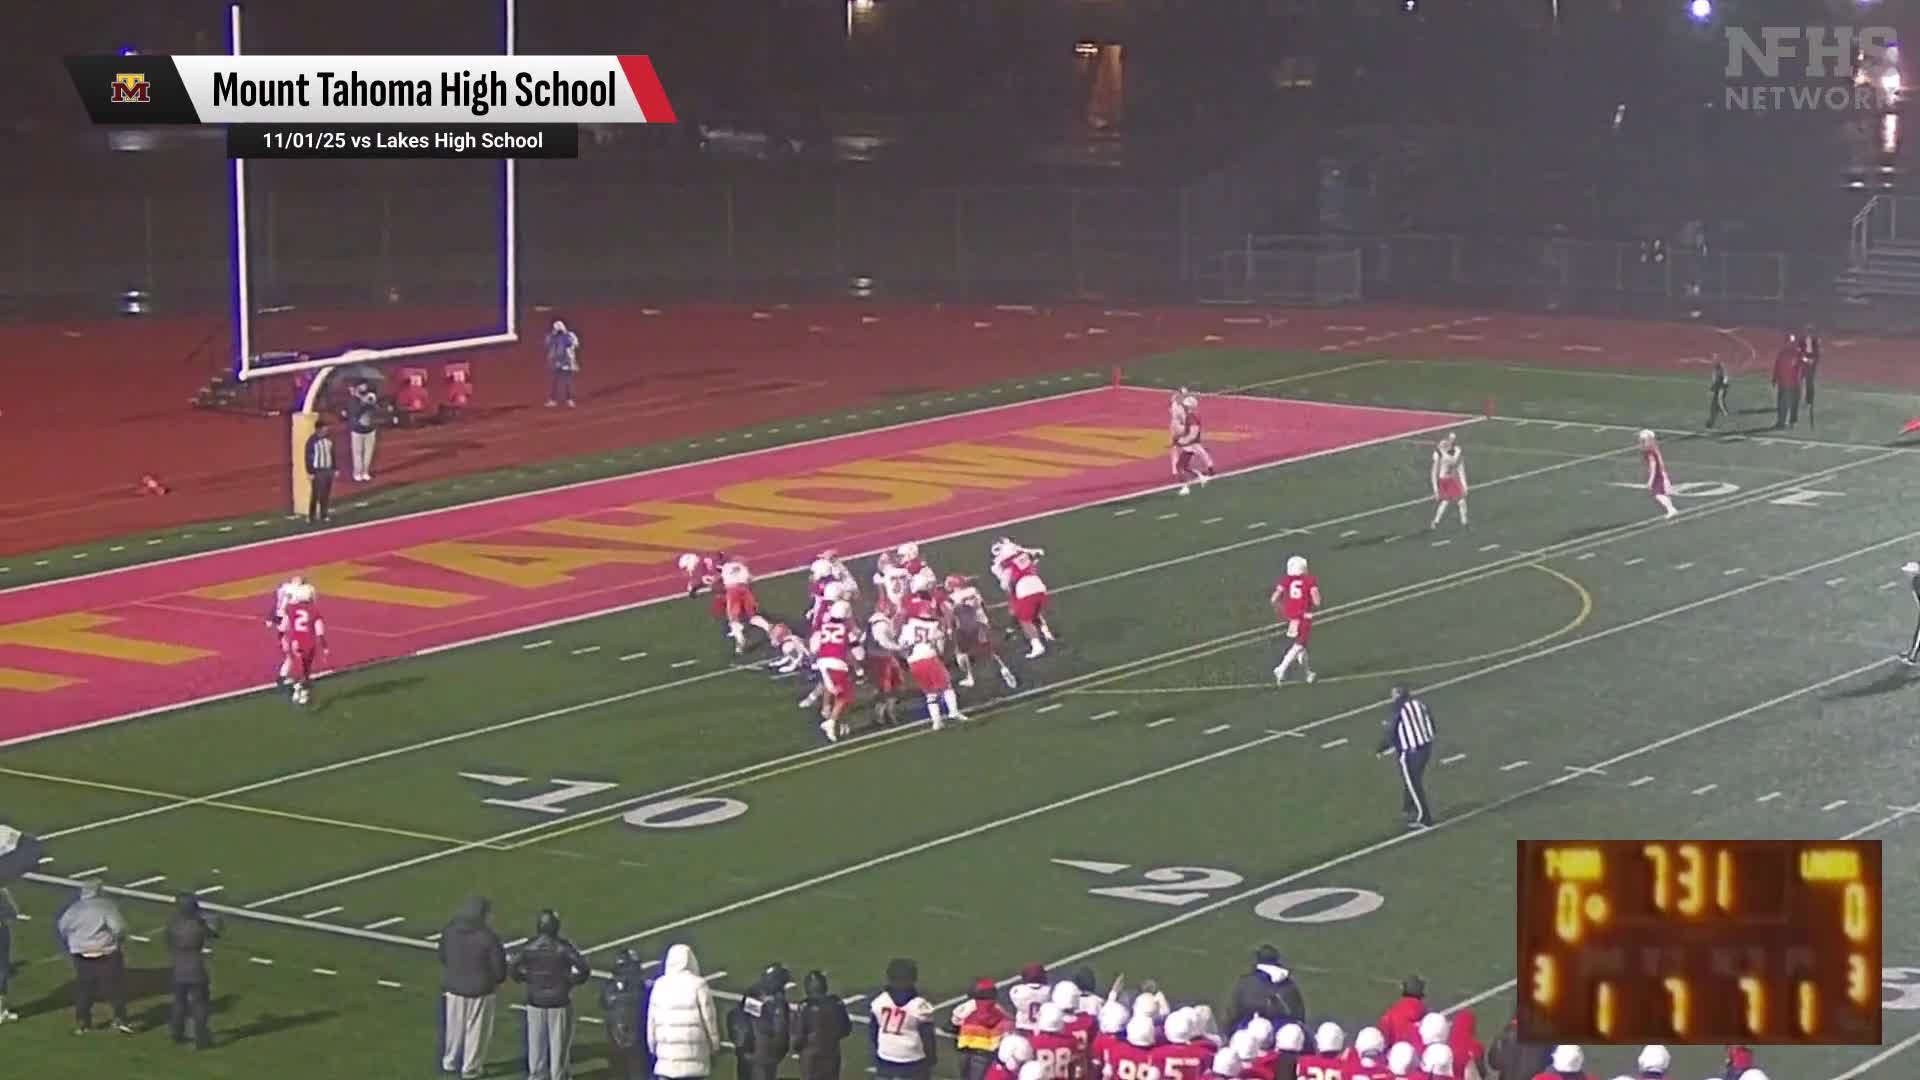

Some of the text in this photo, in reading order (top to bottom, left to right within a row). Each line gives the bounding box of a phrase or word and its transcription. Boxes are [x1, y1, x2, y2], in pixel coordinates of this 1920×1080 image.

[185, 423, 1255, 609] TAHOMA
[1290, 579, 1303, 600] 6
[294, 609, 309, 632] 2
[820, 622, 847, 645] 52
